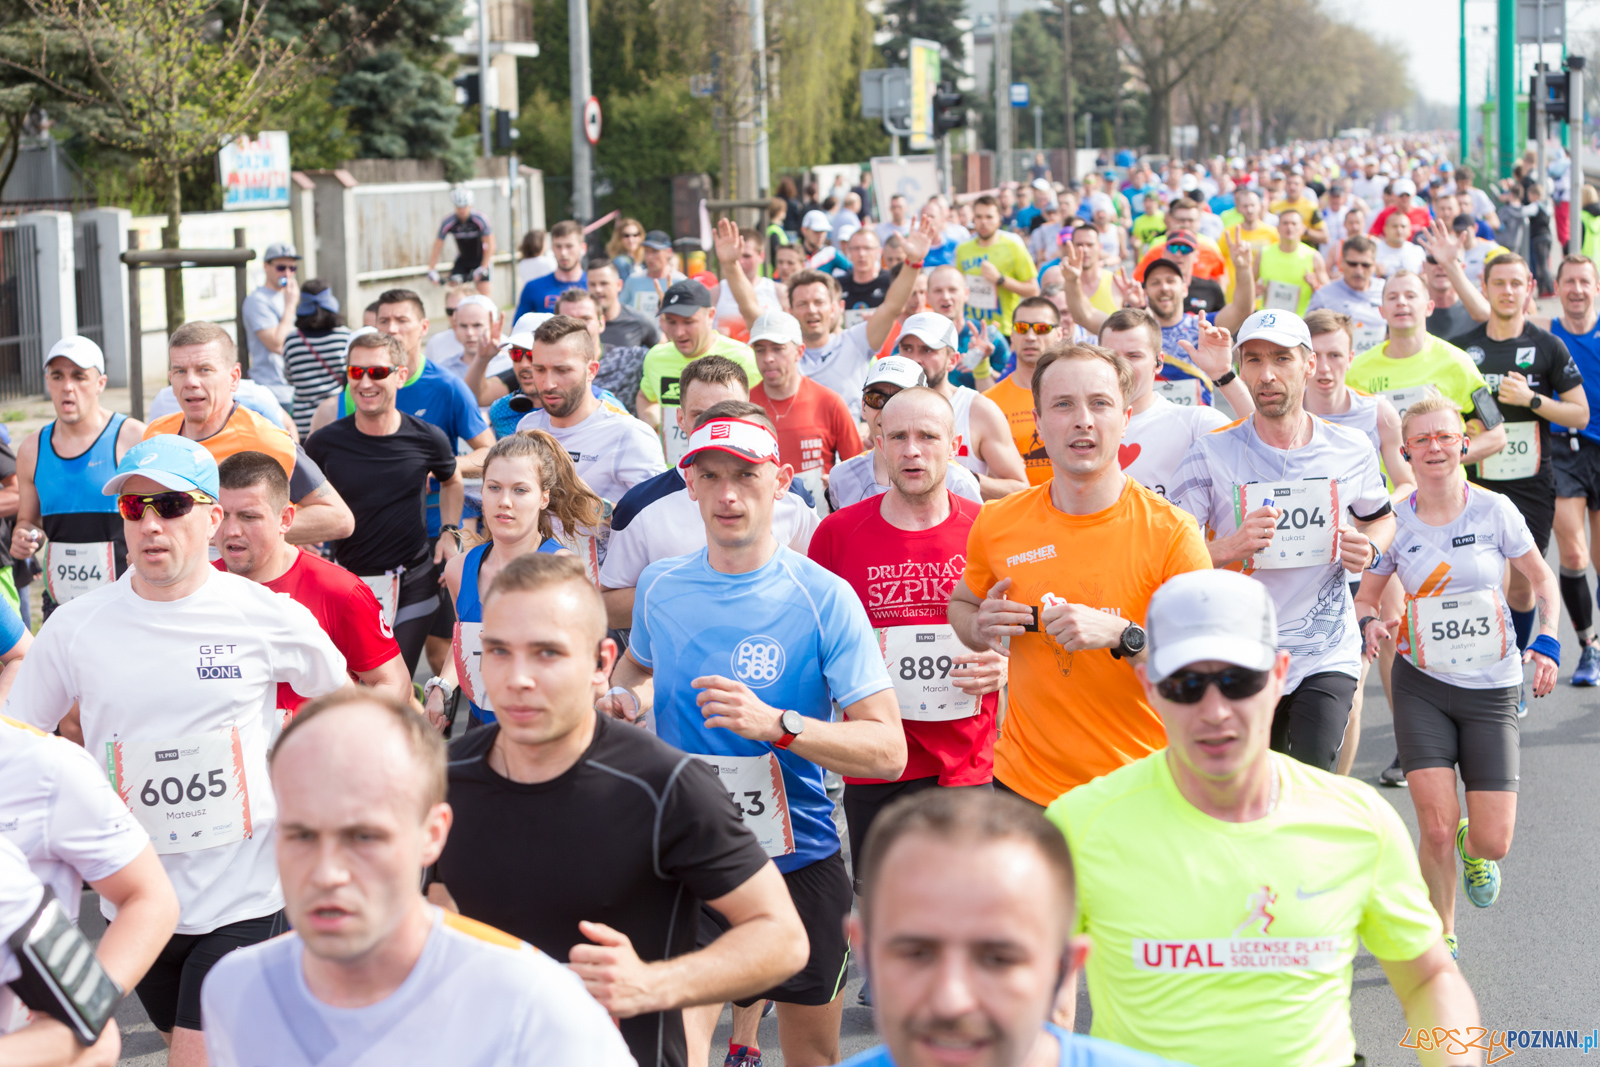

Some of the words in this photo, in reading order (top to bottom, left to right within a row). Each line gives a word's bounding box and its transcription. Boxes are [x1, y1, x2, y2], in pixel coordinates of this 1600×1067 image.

[1502, 441, 1528, 455] 30
[1276, 507, 1326, 530] 204
[1006, 544, 1056, 568] FINISHER
[57, 564, 102, 581] 9564
[867, 559, 955, 581] DRUŻYNA
[868, 578, 961, 607] SZPIK
[1431, 616, 1491, 641] 5843
[200, 644, 237, 655] GET
[200, 656, 216, 666] IT
[200, 666, 239, 679] DONE
[922, 685, 948, 693] Marcin
[140, 768, 227, 807] 6065
[166, 808, 207, 820] Mateusz
[1143, 942, 1224, 968] UTAL
[1230, 942, 1290, 954] LICENSE
[1231, 955, 1309, 967] SOLUTIONS
